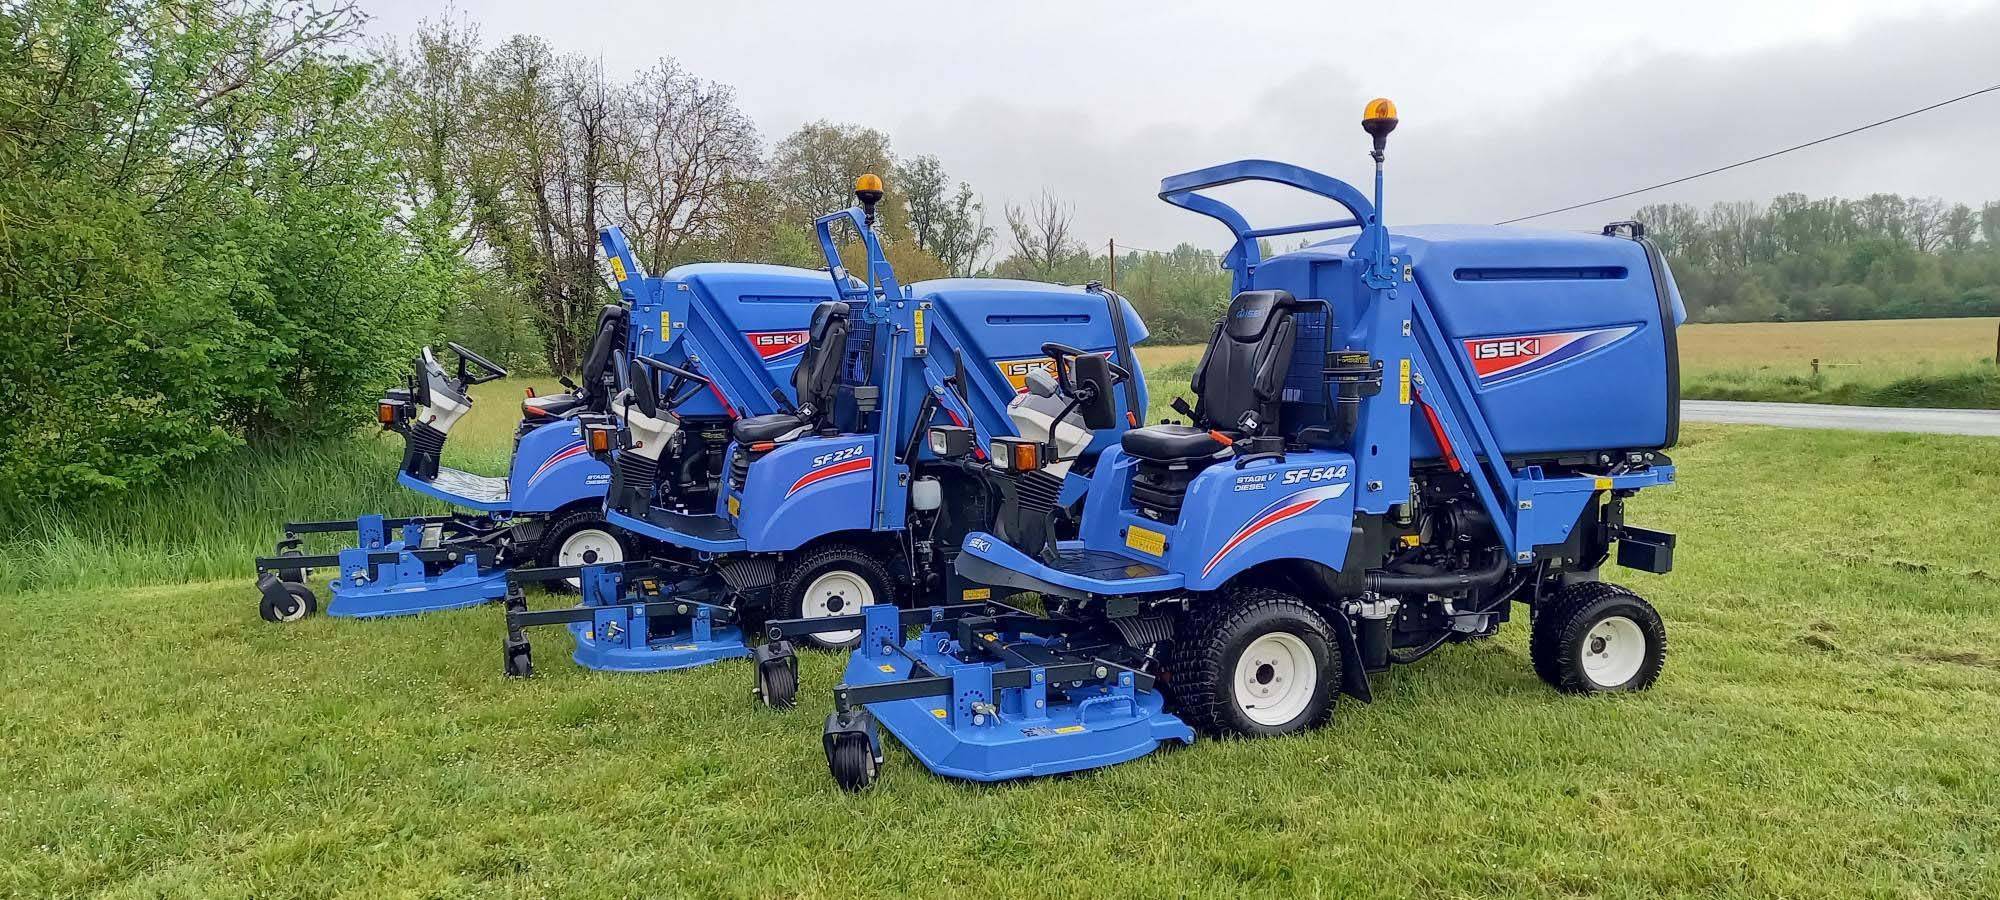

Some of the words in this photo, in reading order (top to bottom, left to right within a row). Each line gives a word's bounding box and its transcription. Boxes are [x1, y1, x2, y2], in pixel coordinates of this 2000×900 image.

[756, 334, 802, 346] ISEKI
[1475, 339, 1540, 360] ISEKI
[833, 445, 864, 461] 224
[1236, 475, 1267, 484] STAGE
[1267, 472, 1277, 481] V
[1281, 469, 1311, 485] SF
[1309, 465, 1348, 482] 544
[1234, 483, 1267, 492] DIESEL
